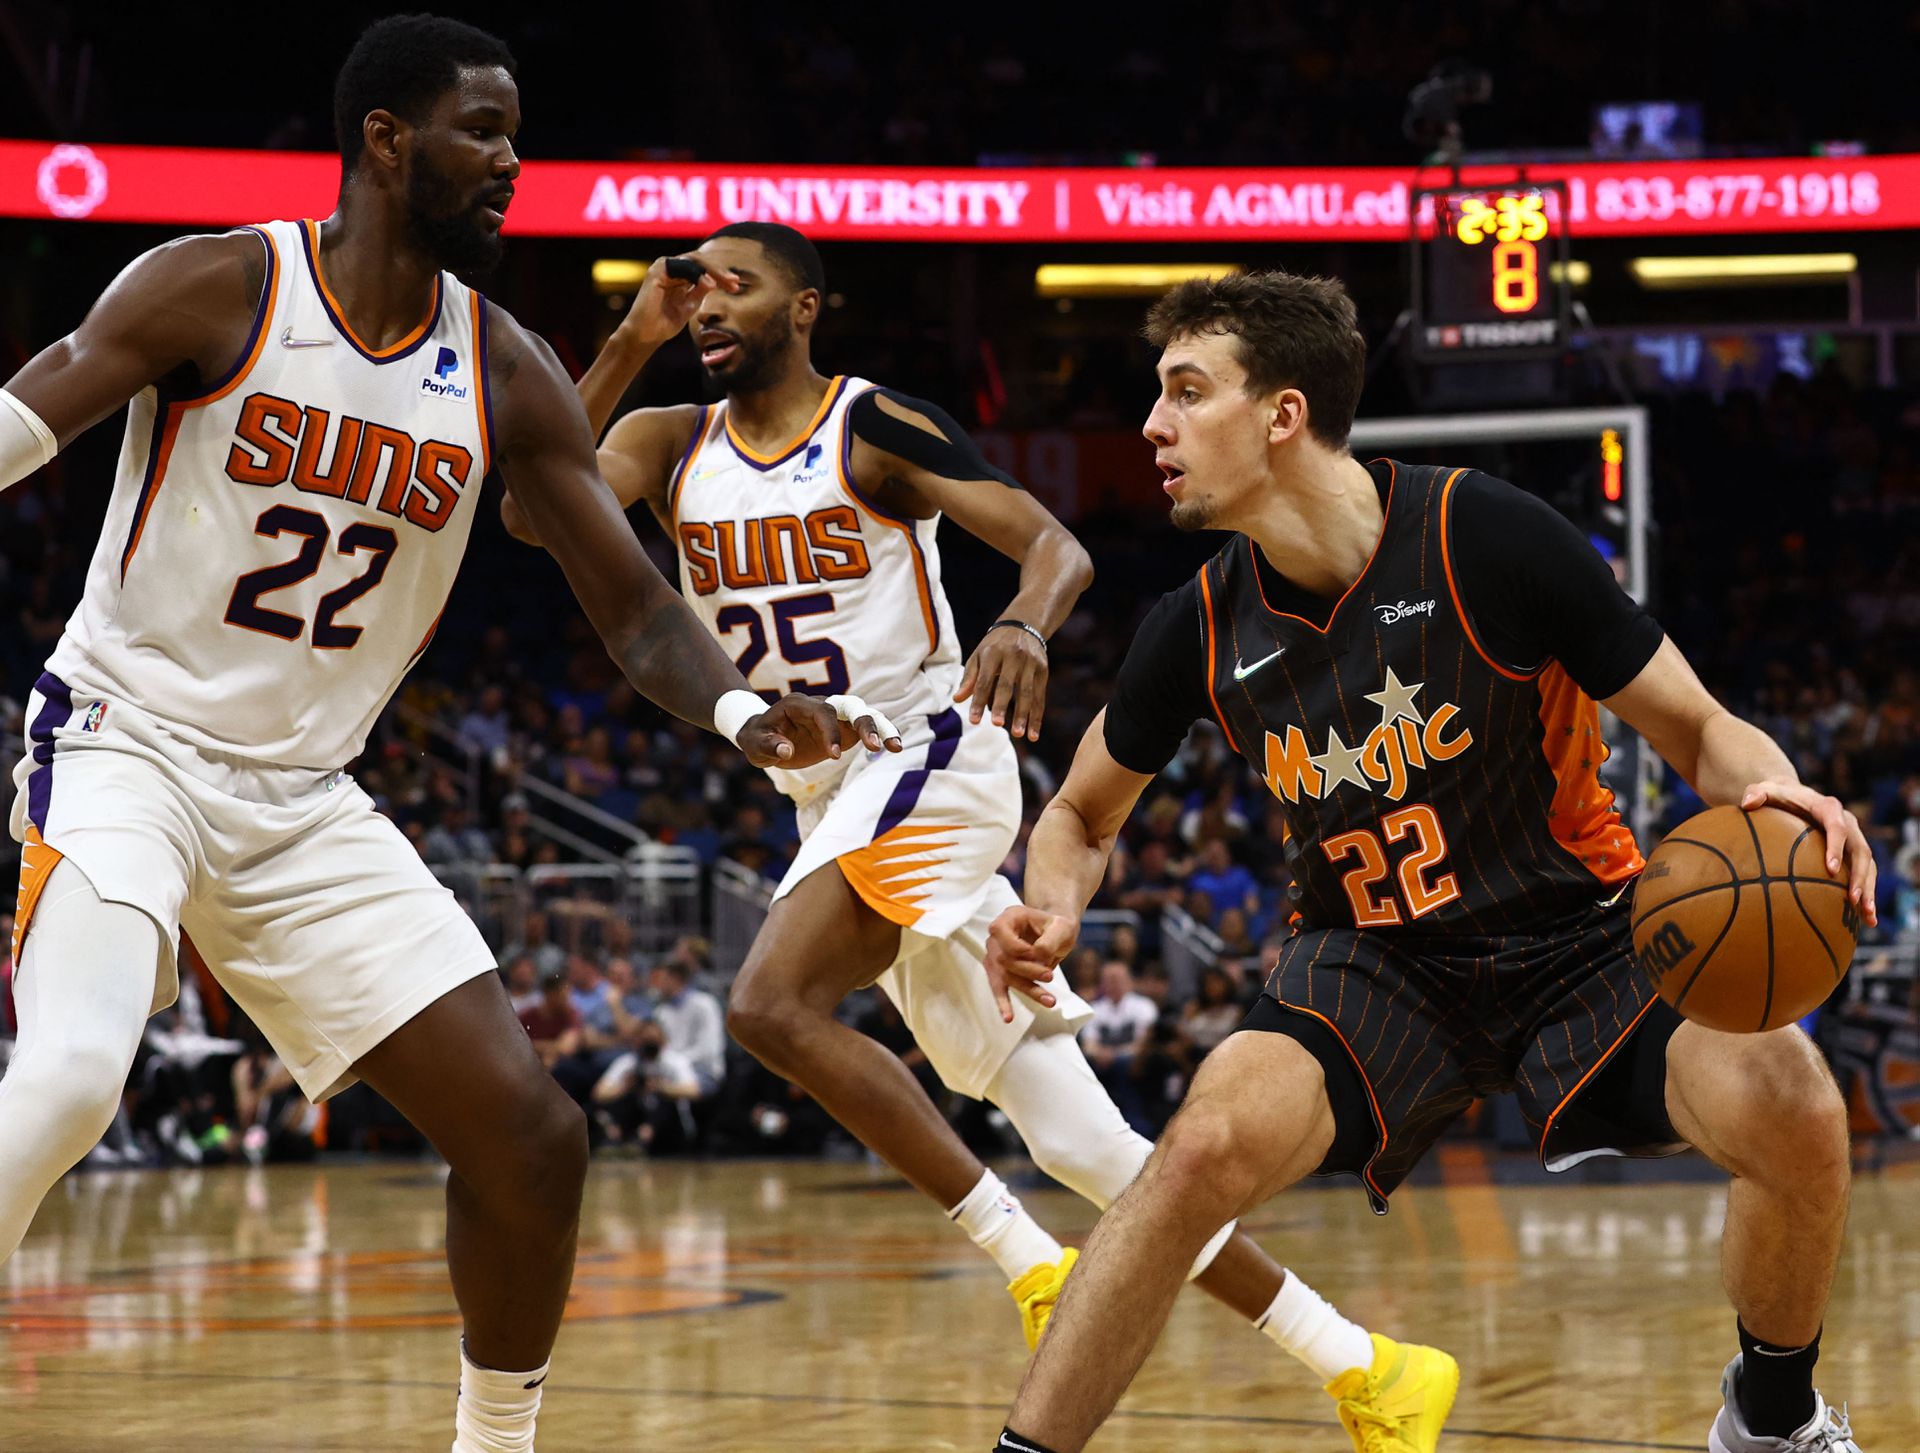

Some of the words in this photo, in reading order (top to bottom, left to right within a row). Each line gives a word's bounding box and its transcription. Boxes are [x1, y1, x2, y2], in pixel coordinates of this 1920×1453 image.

[585, 175, 706, 222] AGM
[718, 177, 1030, 228] UNIVERSITY
[1095, 181, 1194, 227] Visit
[1596, 172, 1880, 222] 833-877-1918
[1492, 239, 1538, 313] 8
[421, 377, 467, 399] PayPal
[225, 391, 472, 533] SUNS
[224, 503, 397, 650] 22
[679, 505, 871, 596] SUNS
[716, 593, 850, 705] 25
[1319, 803, 1461, 928] 22
